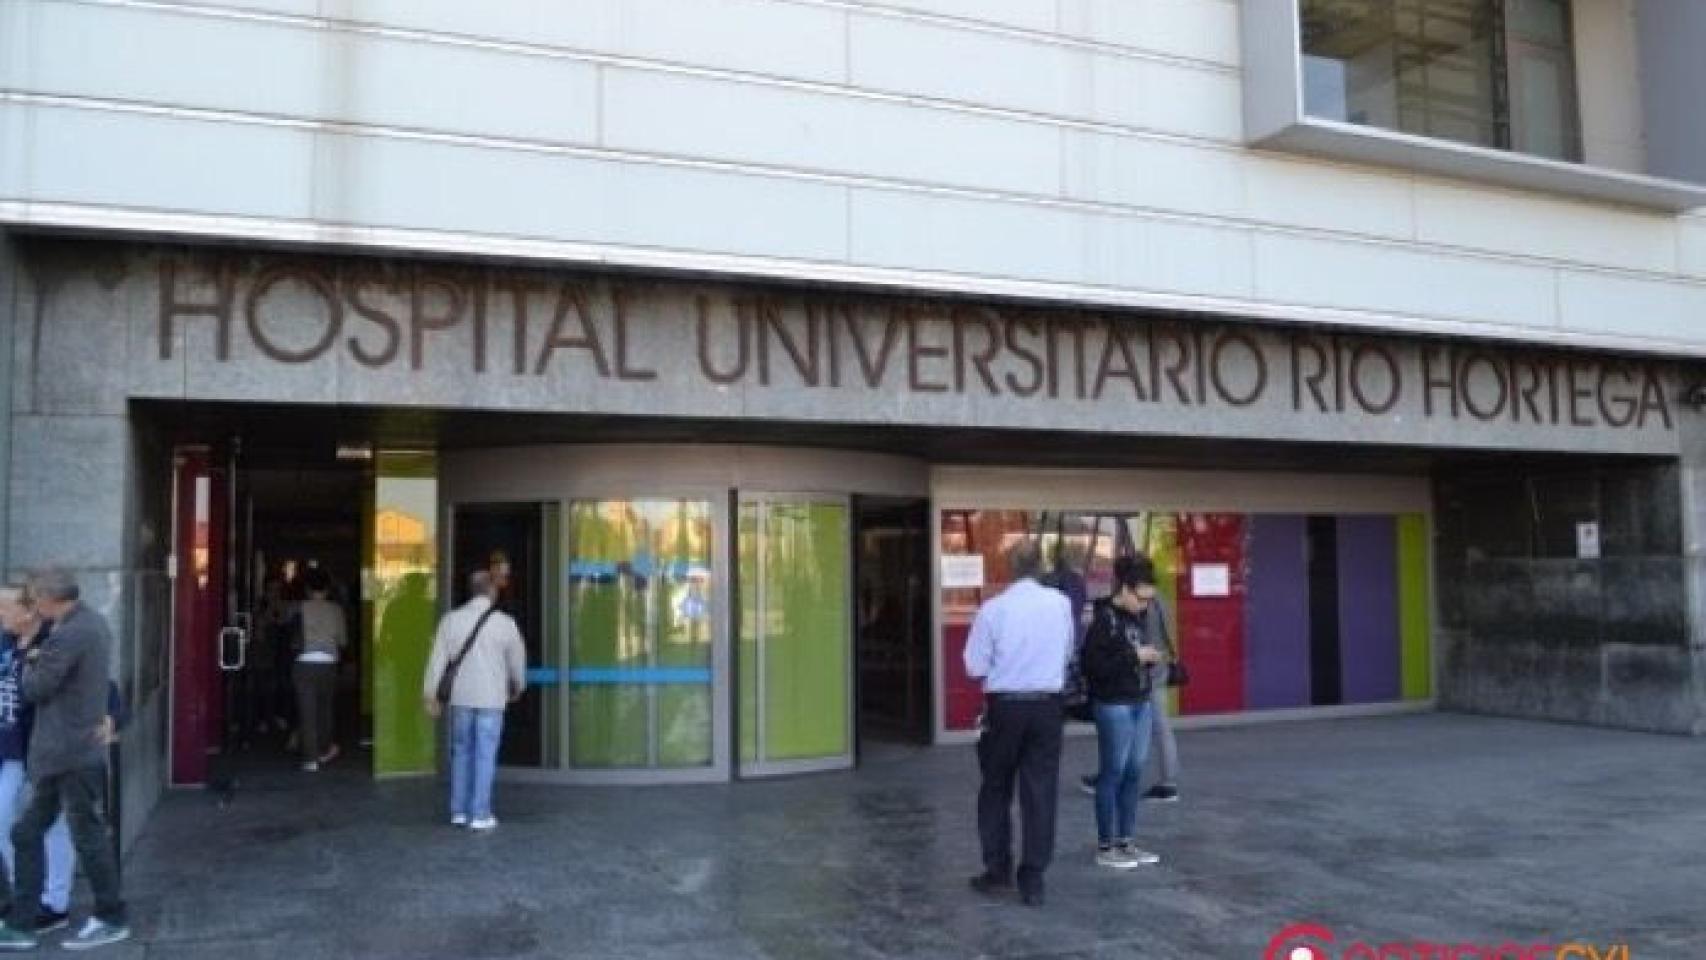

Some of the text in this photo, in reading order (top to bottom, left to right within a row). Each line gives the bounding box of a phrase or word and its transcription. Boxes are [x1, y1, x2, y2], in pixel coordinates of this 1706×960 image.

[157, 258, 657, 380] HOSPITAL
[695, 294, 1268, 406] UNIVERSITARIO
[1422, 346, 1673, 430] HORTEGA
